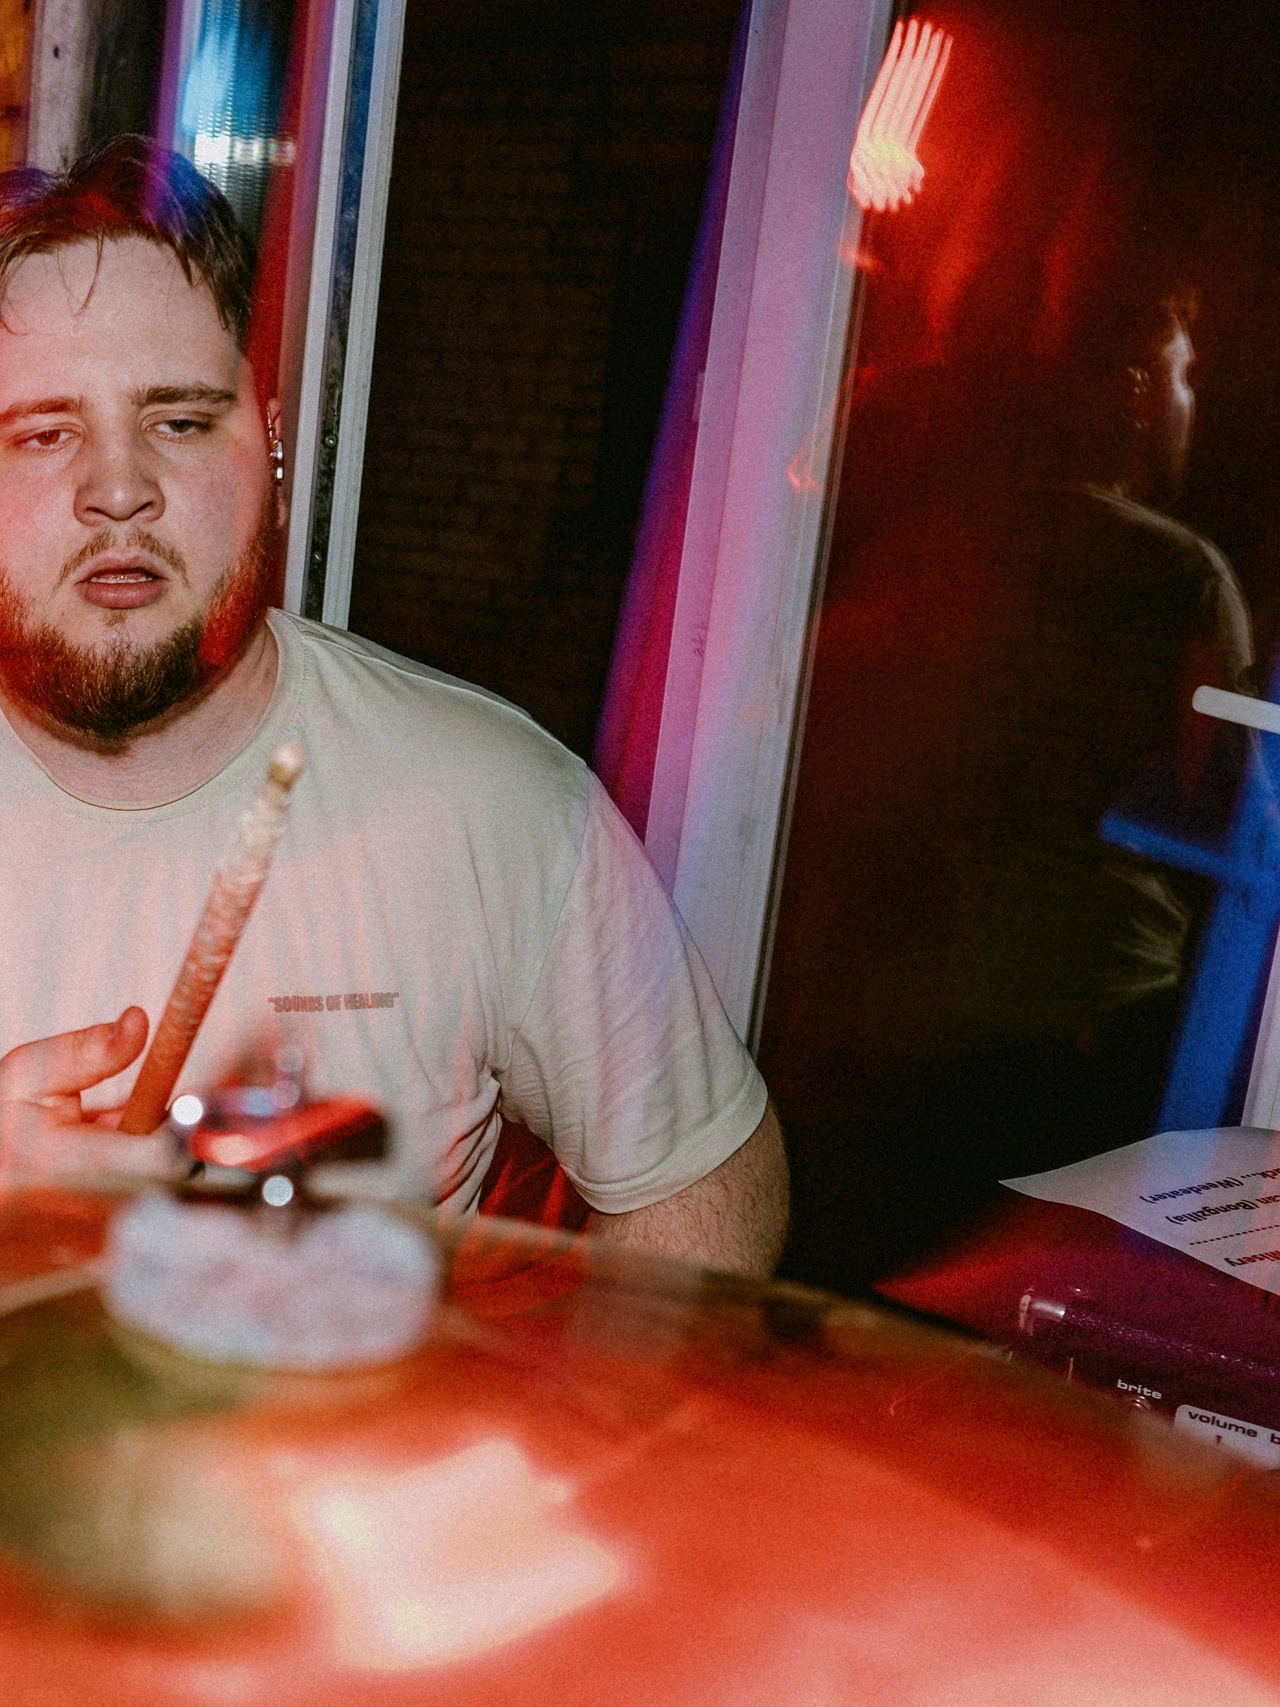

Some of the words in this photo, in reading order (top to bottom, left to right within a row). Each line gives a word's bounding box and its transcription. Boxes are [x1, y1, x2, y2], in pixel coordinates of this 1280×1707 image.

[325, 995, 342, 1011] OF
[1139, 1177, 1245, 1204] (Weedeater)
[1165, 1199, 1260, 1226] (Bongzilla)
[1117, 1379, 1162, 1400] brite
[1187, 1411, 1259, 1438] volume
